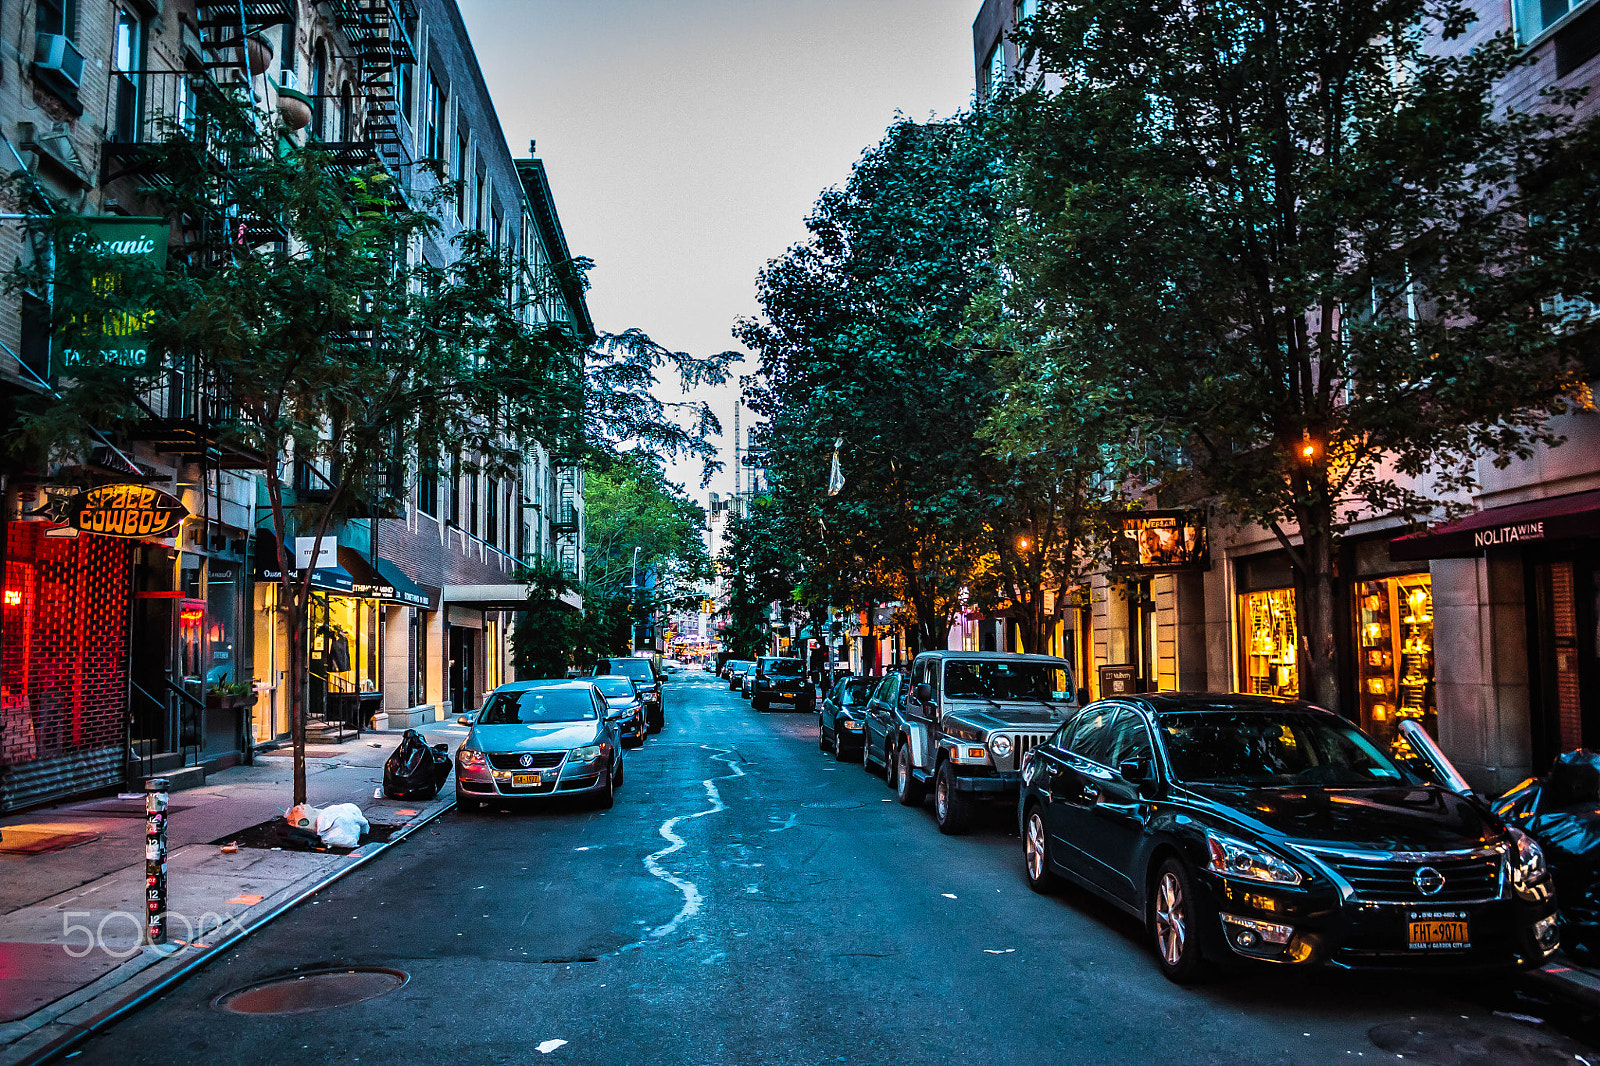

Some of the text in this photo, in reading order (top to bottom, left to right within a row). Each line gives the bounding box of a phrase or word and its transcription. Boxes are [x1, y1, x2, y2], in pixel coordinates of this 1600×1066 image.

[80, 509, 171, 535] COWBOY
[1474, 521, 1544, 548] NOLITA WINE
[148, 889, 159, 900] 12
[150, 915, 160, 925] 12
